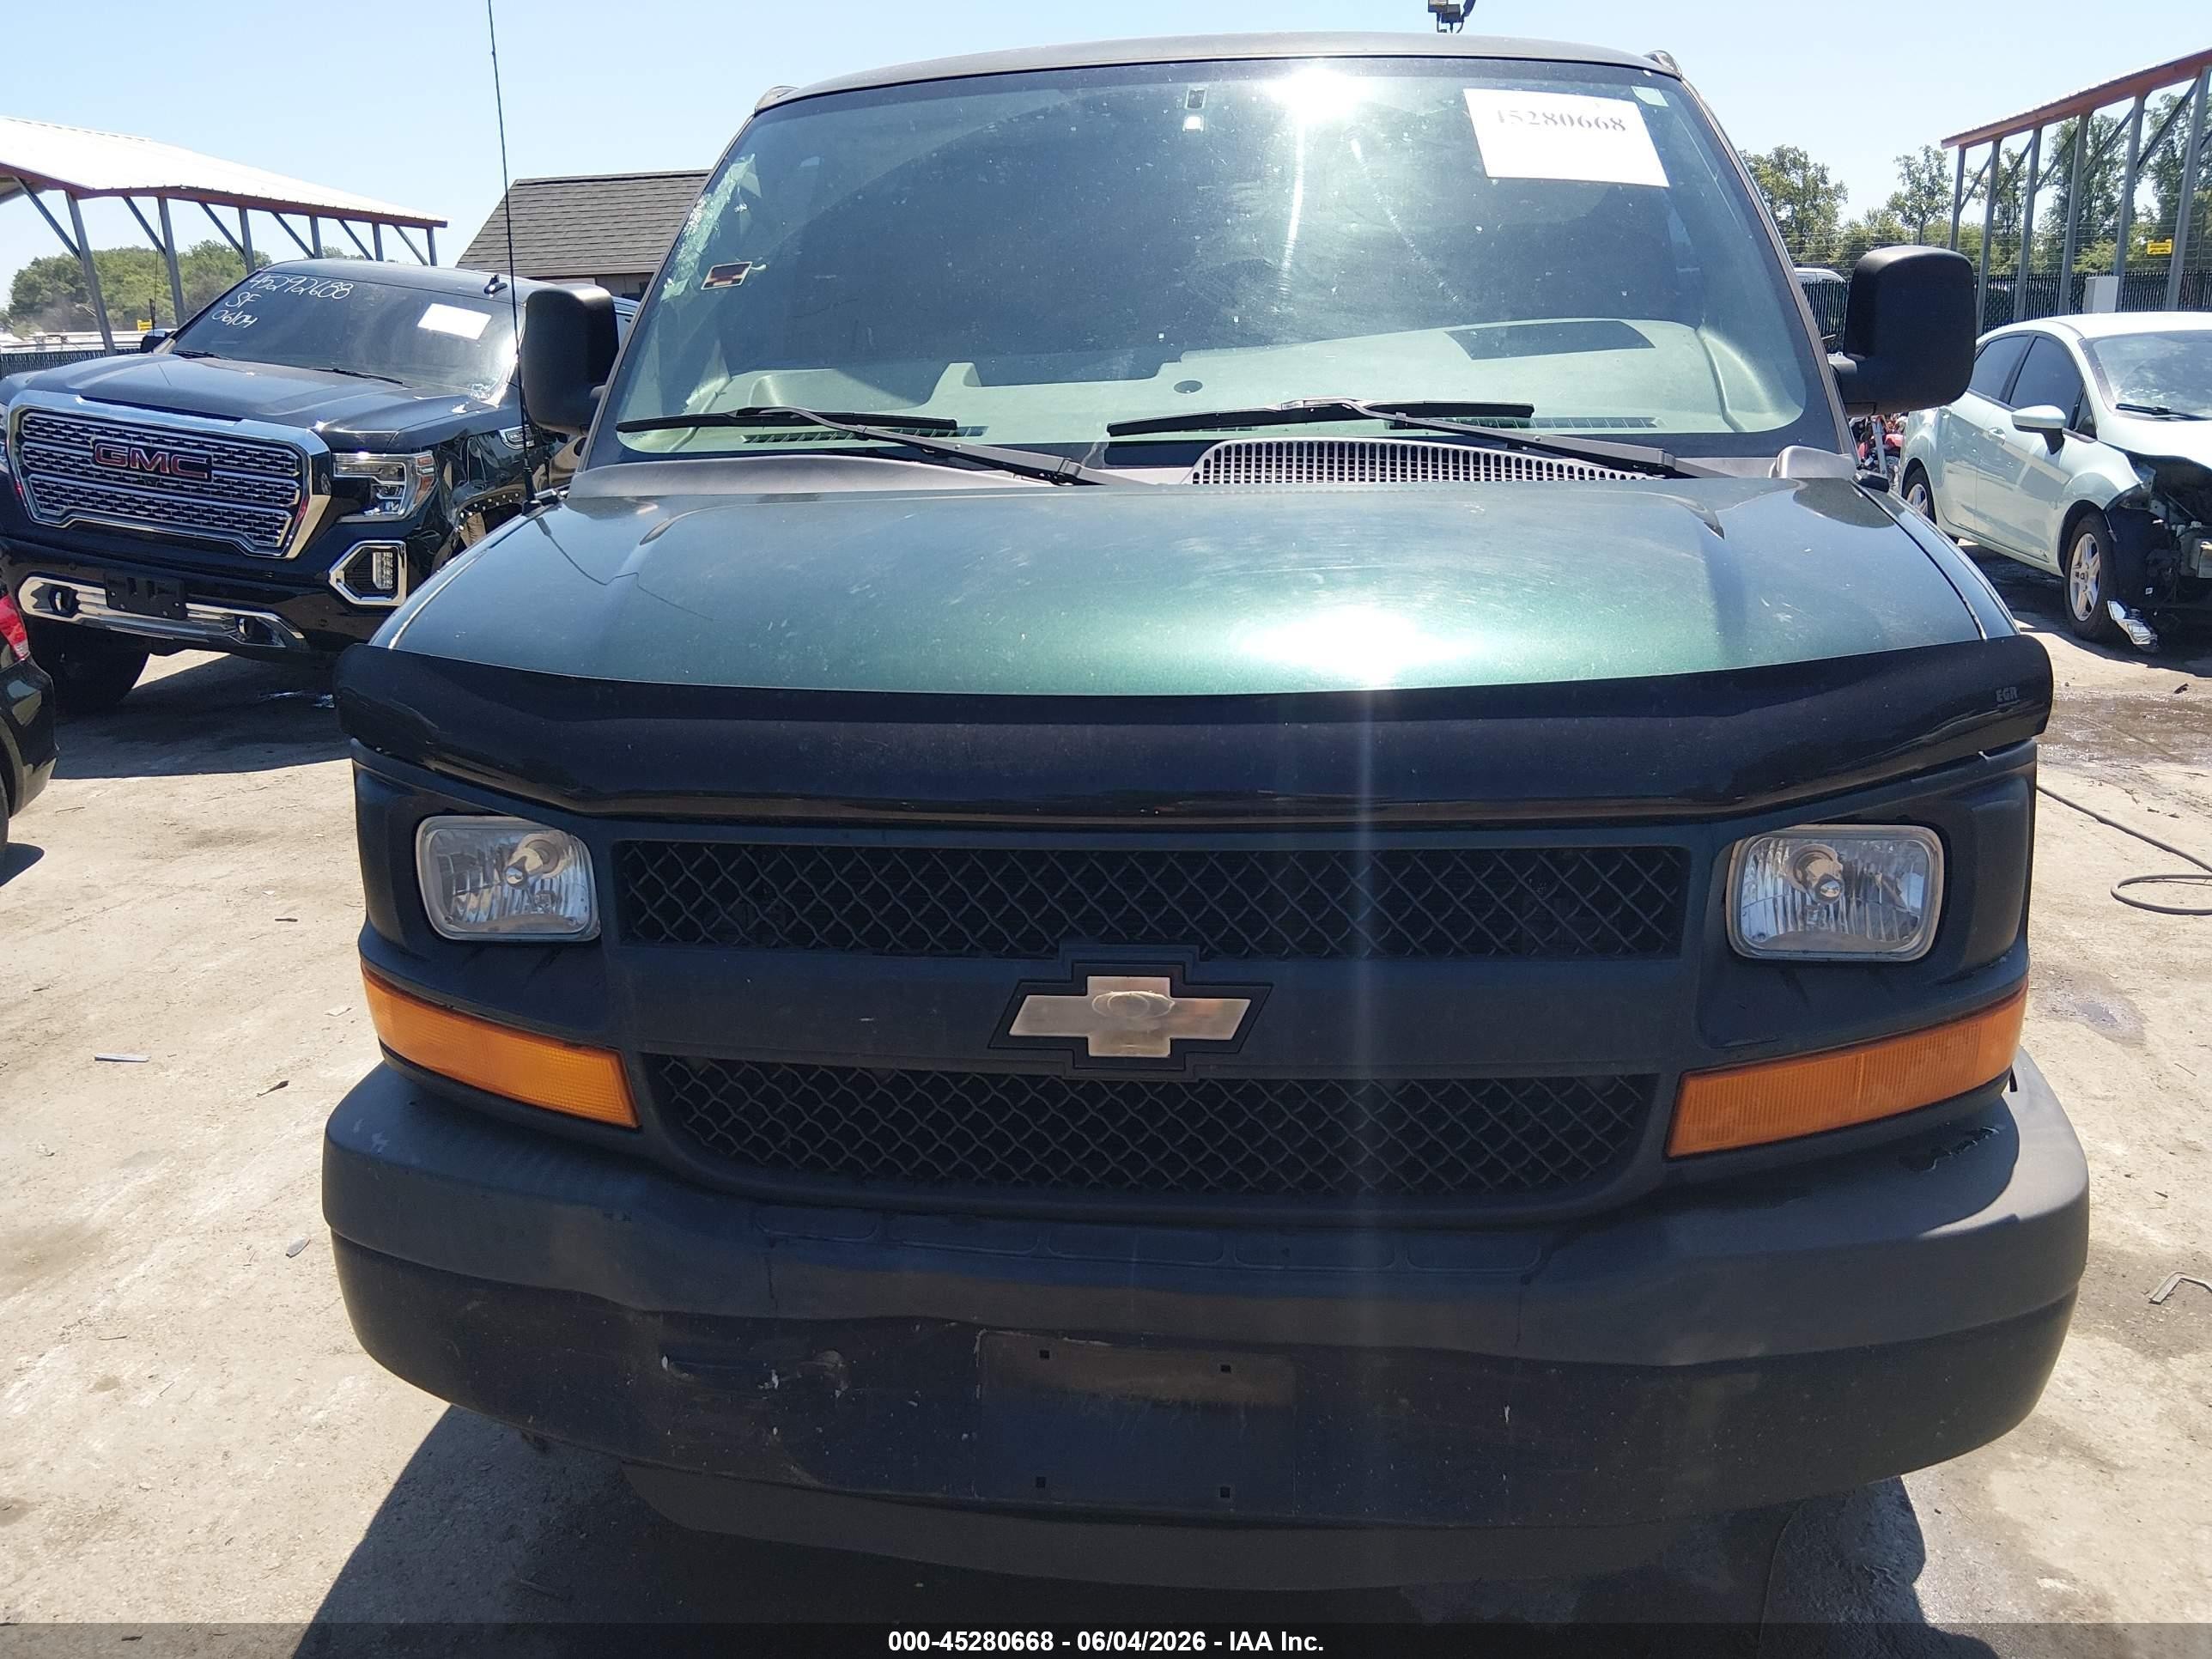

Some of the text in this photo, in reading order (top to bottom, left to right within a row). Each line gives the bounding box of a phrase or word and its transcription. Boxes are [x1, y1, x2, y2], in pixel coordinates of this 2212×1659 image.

[225, 291, 263, 308] SF
[211, 308, 258, 329] 06/04
[94, 442, 209, 481] GMC
